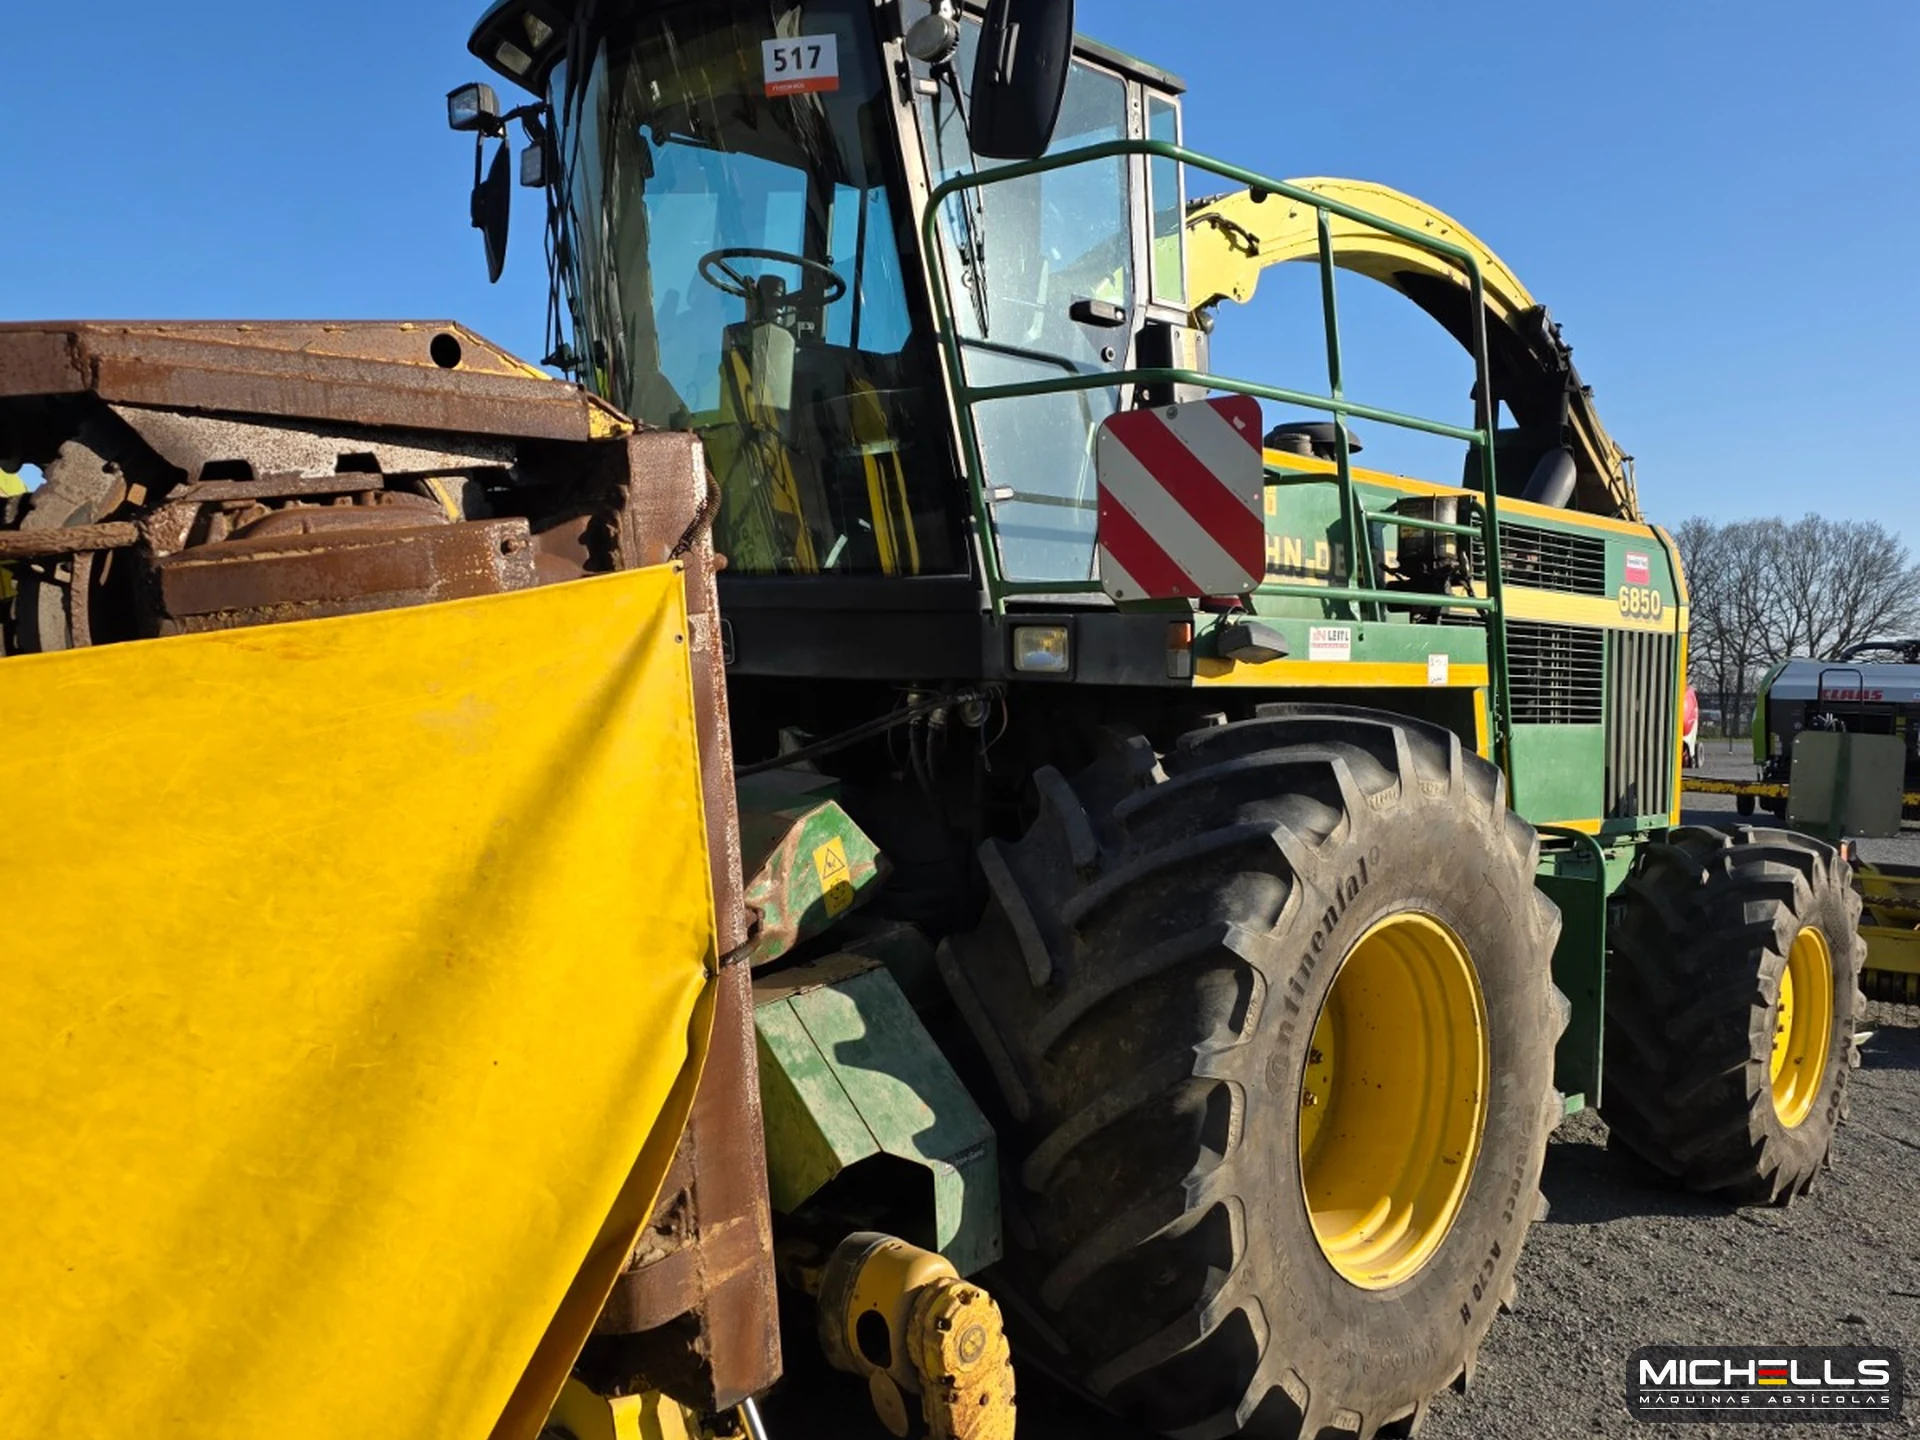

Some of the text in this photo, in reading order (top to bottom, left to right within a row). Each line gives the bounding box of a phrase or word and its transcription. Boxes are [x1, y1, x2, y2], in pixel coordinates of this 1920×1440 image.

[773, 45, 821, 72] 517
[1619, 585, 1661, 616] 6850
[1820, 689, 1884, 700] CLAAS
